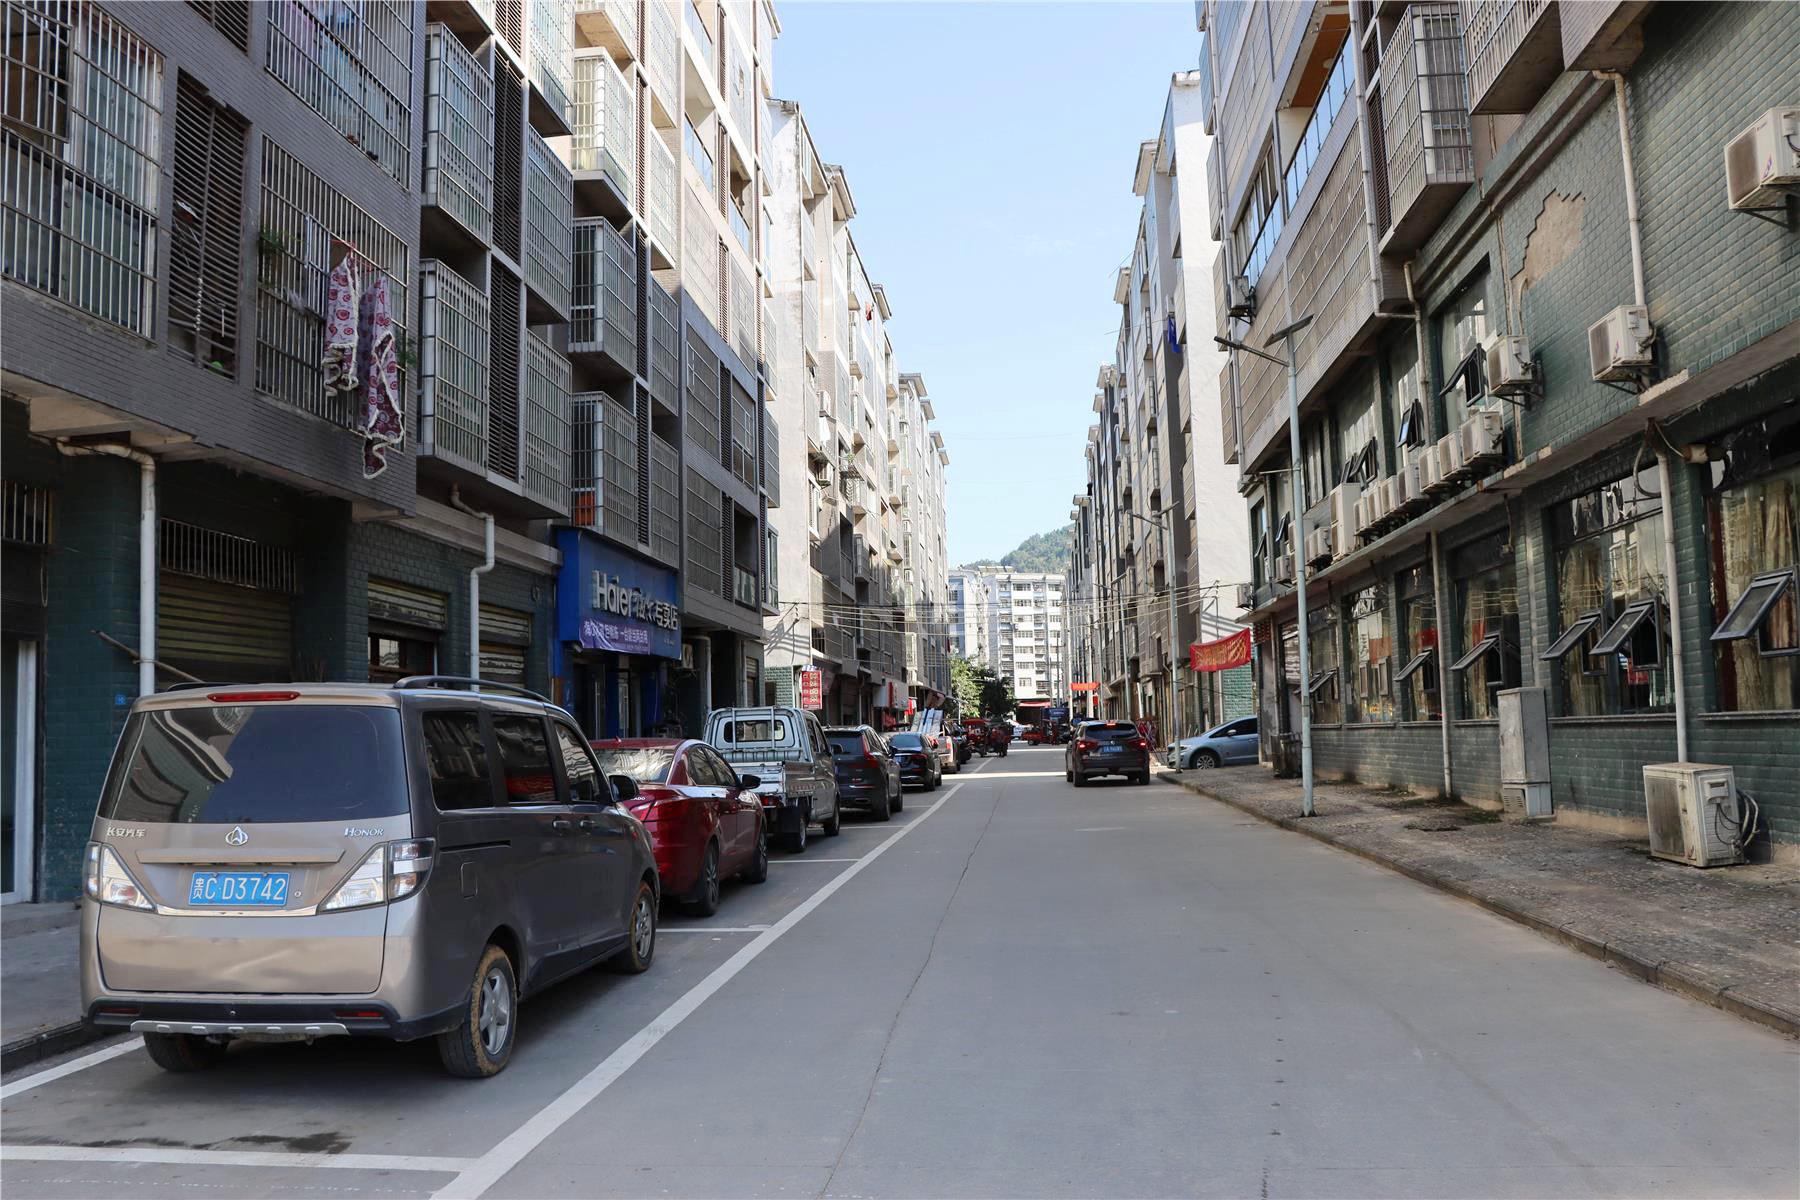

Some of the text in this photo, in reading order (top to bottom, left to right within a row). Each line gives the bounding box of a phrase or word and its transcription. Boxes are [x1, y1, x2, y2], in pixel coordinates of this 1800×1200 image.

[592, 570, 633, 617] Haier
[107, 827, 146, 838] 长安汽车
[344, 827, 385, 837] HONOR
